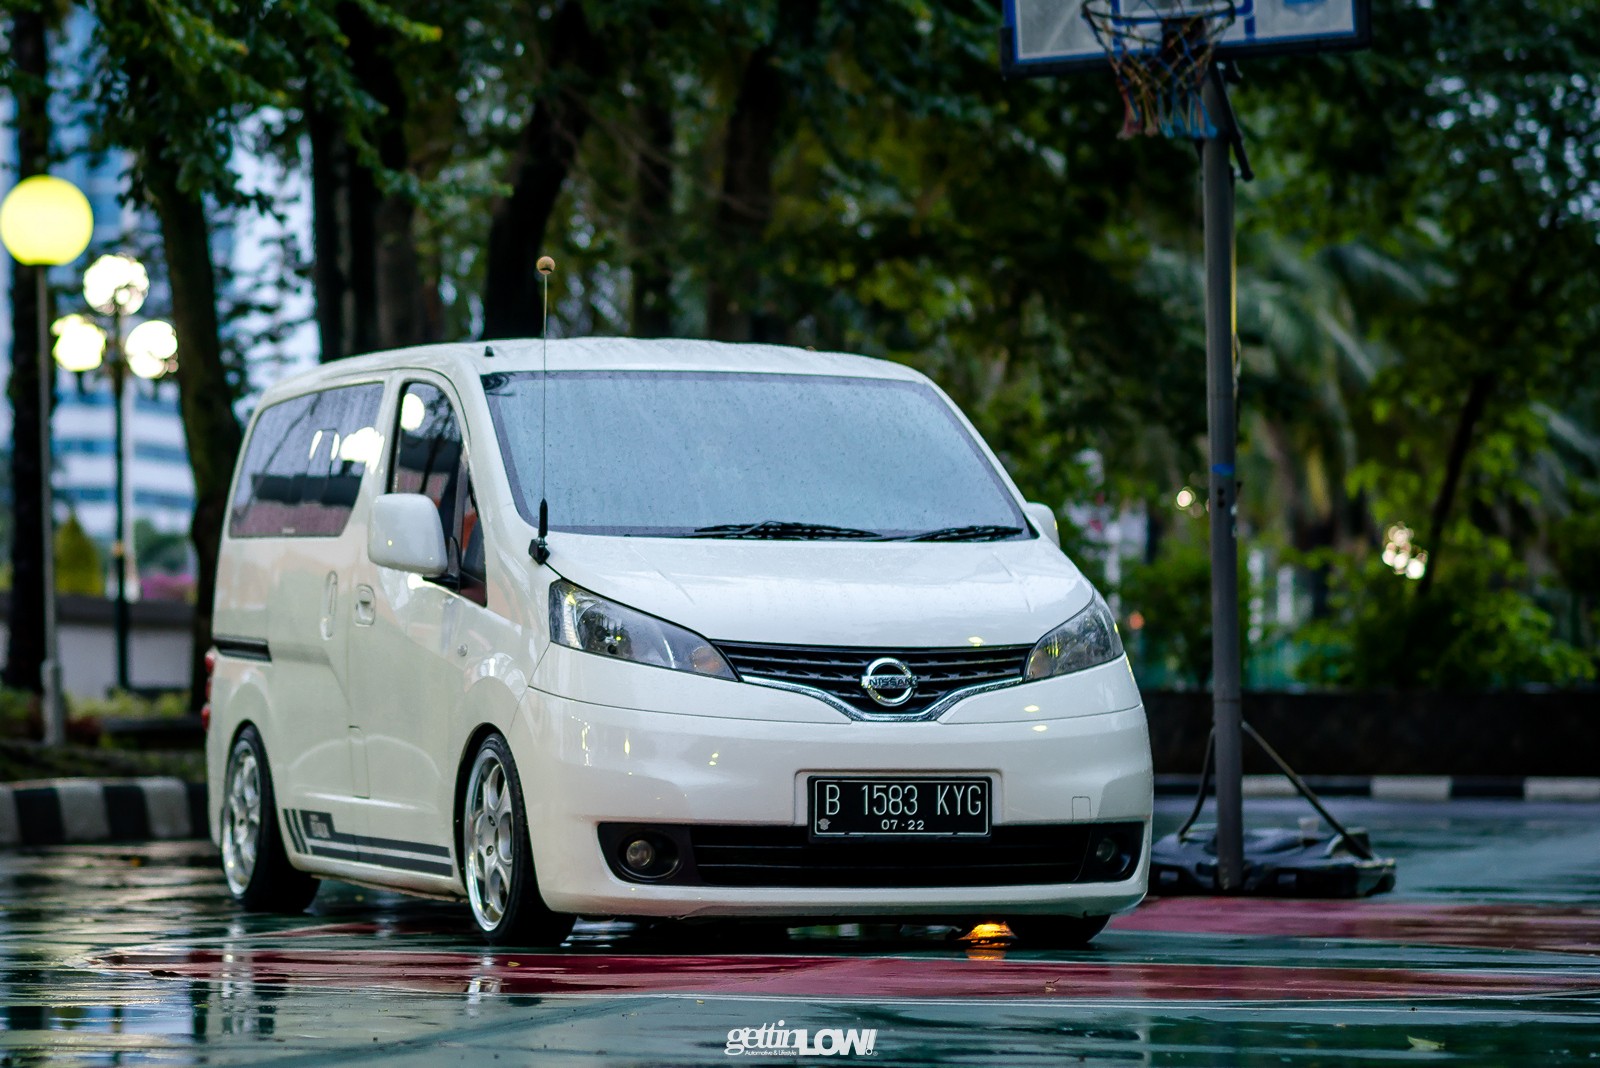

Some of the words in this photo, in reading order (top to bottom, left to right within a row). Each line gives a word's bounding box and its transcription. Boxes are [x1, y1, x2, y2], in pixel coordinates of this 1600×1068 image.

[869, 676, 911, 687] NISSAN
[825, 784, 841, 816] B
[861, 784, 918, 816] 1583
[936, 784, 983, 816] KYG
